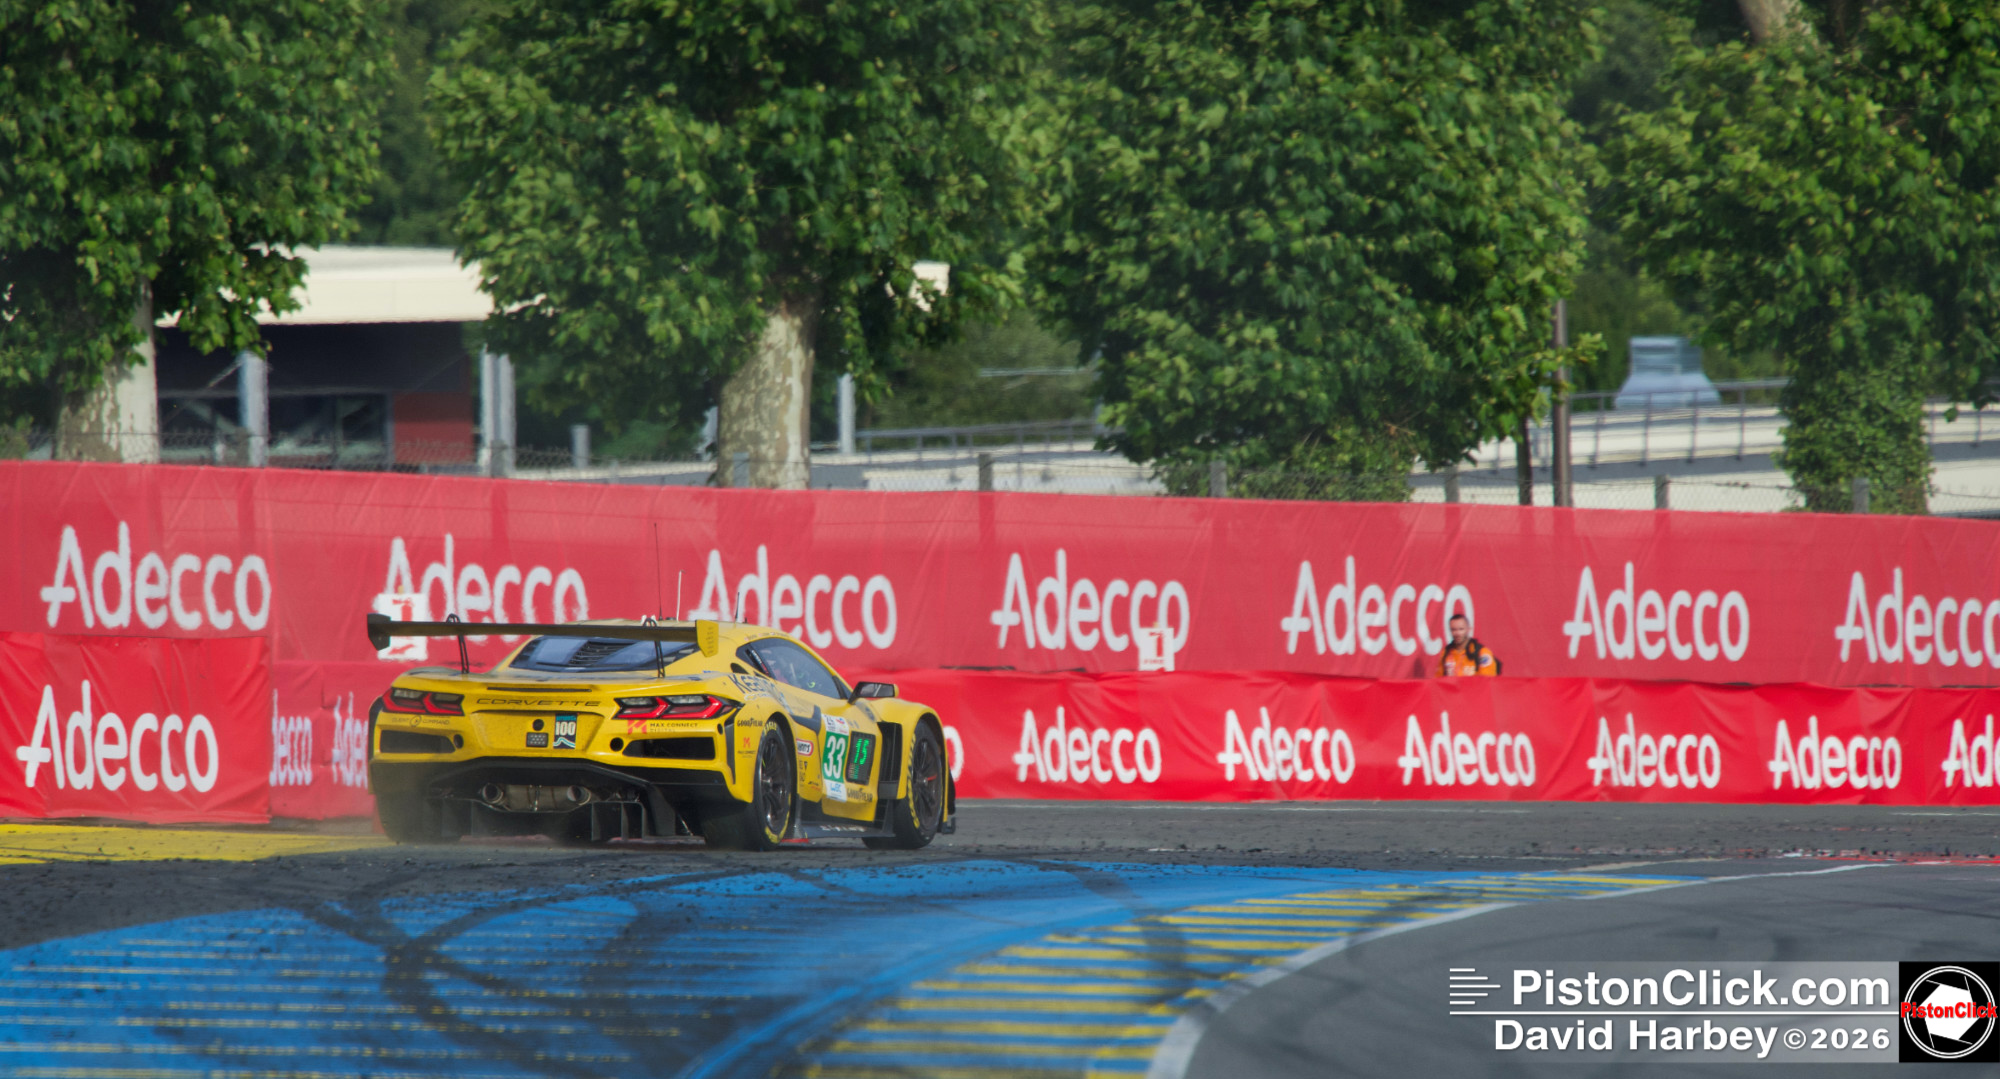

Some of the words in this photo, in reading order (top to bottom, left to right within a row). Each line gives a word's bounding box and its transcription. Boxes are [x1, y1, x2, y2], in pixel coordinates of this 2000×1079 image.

[41, 521, 271, 630] Adecco
[690, 545, 898, 651] Adecco
[991, 549, 1189, 661] Adecco
[1281, 556, 1474, 656] Adecco
[1563, 562, 1749, 661] Adecco
[16, 680, 219, 793] Adecco
[476, 698, 601, 707] CORVETTE
[555, 721, 576, 736] 100
[737, 718, 764, 728] GOODYEAR
[824, 735, 846, 779] 33
[854, 738, 870, 765] 15
[1013, 707, 1162, 783] Adecco
[1217, 707, 1355, 784] Adecco
[1398, 711, 1536, 787] Adecco
[1587, 713, 1720, 789] Adecco
[1769, 715, 1902, 790] Adecco
